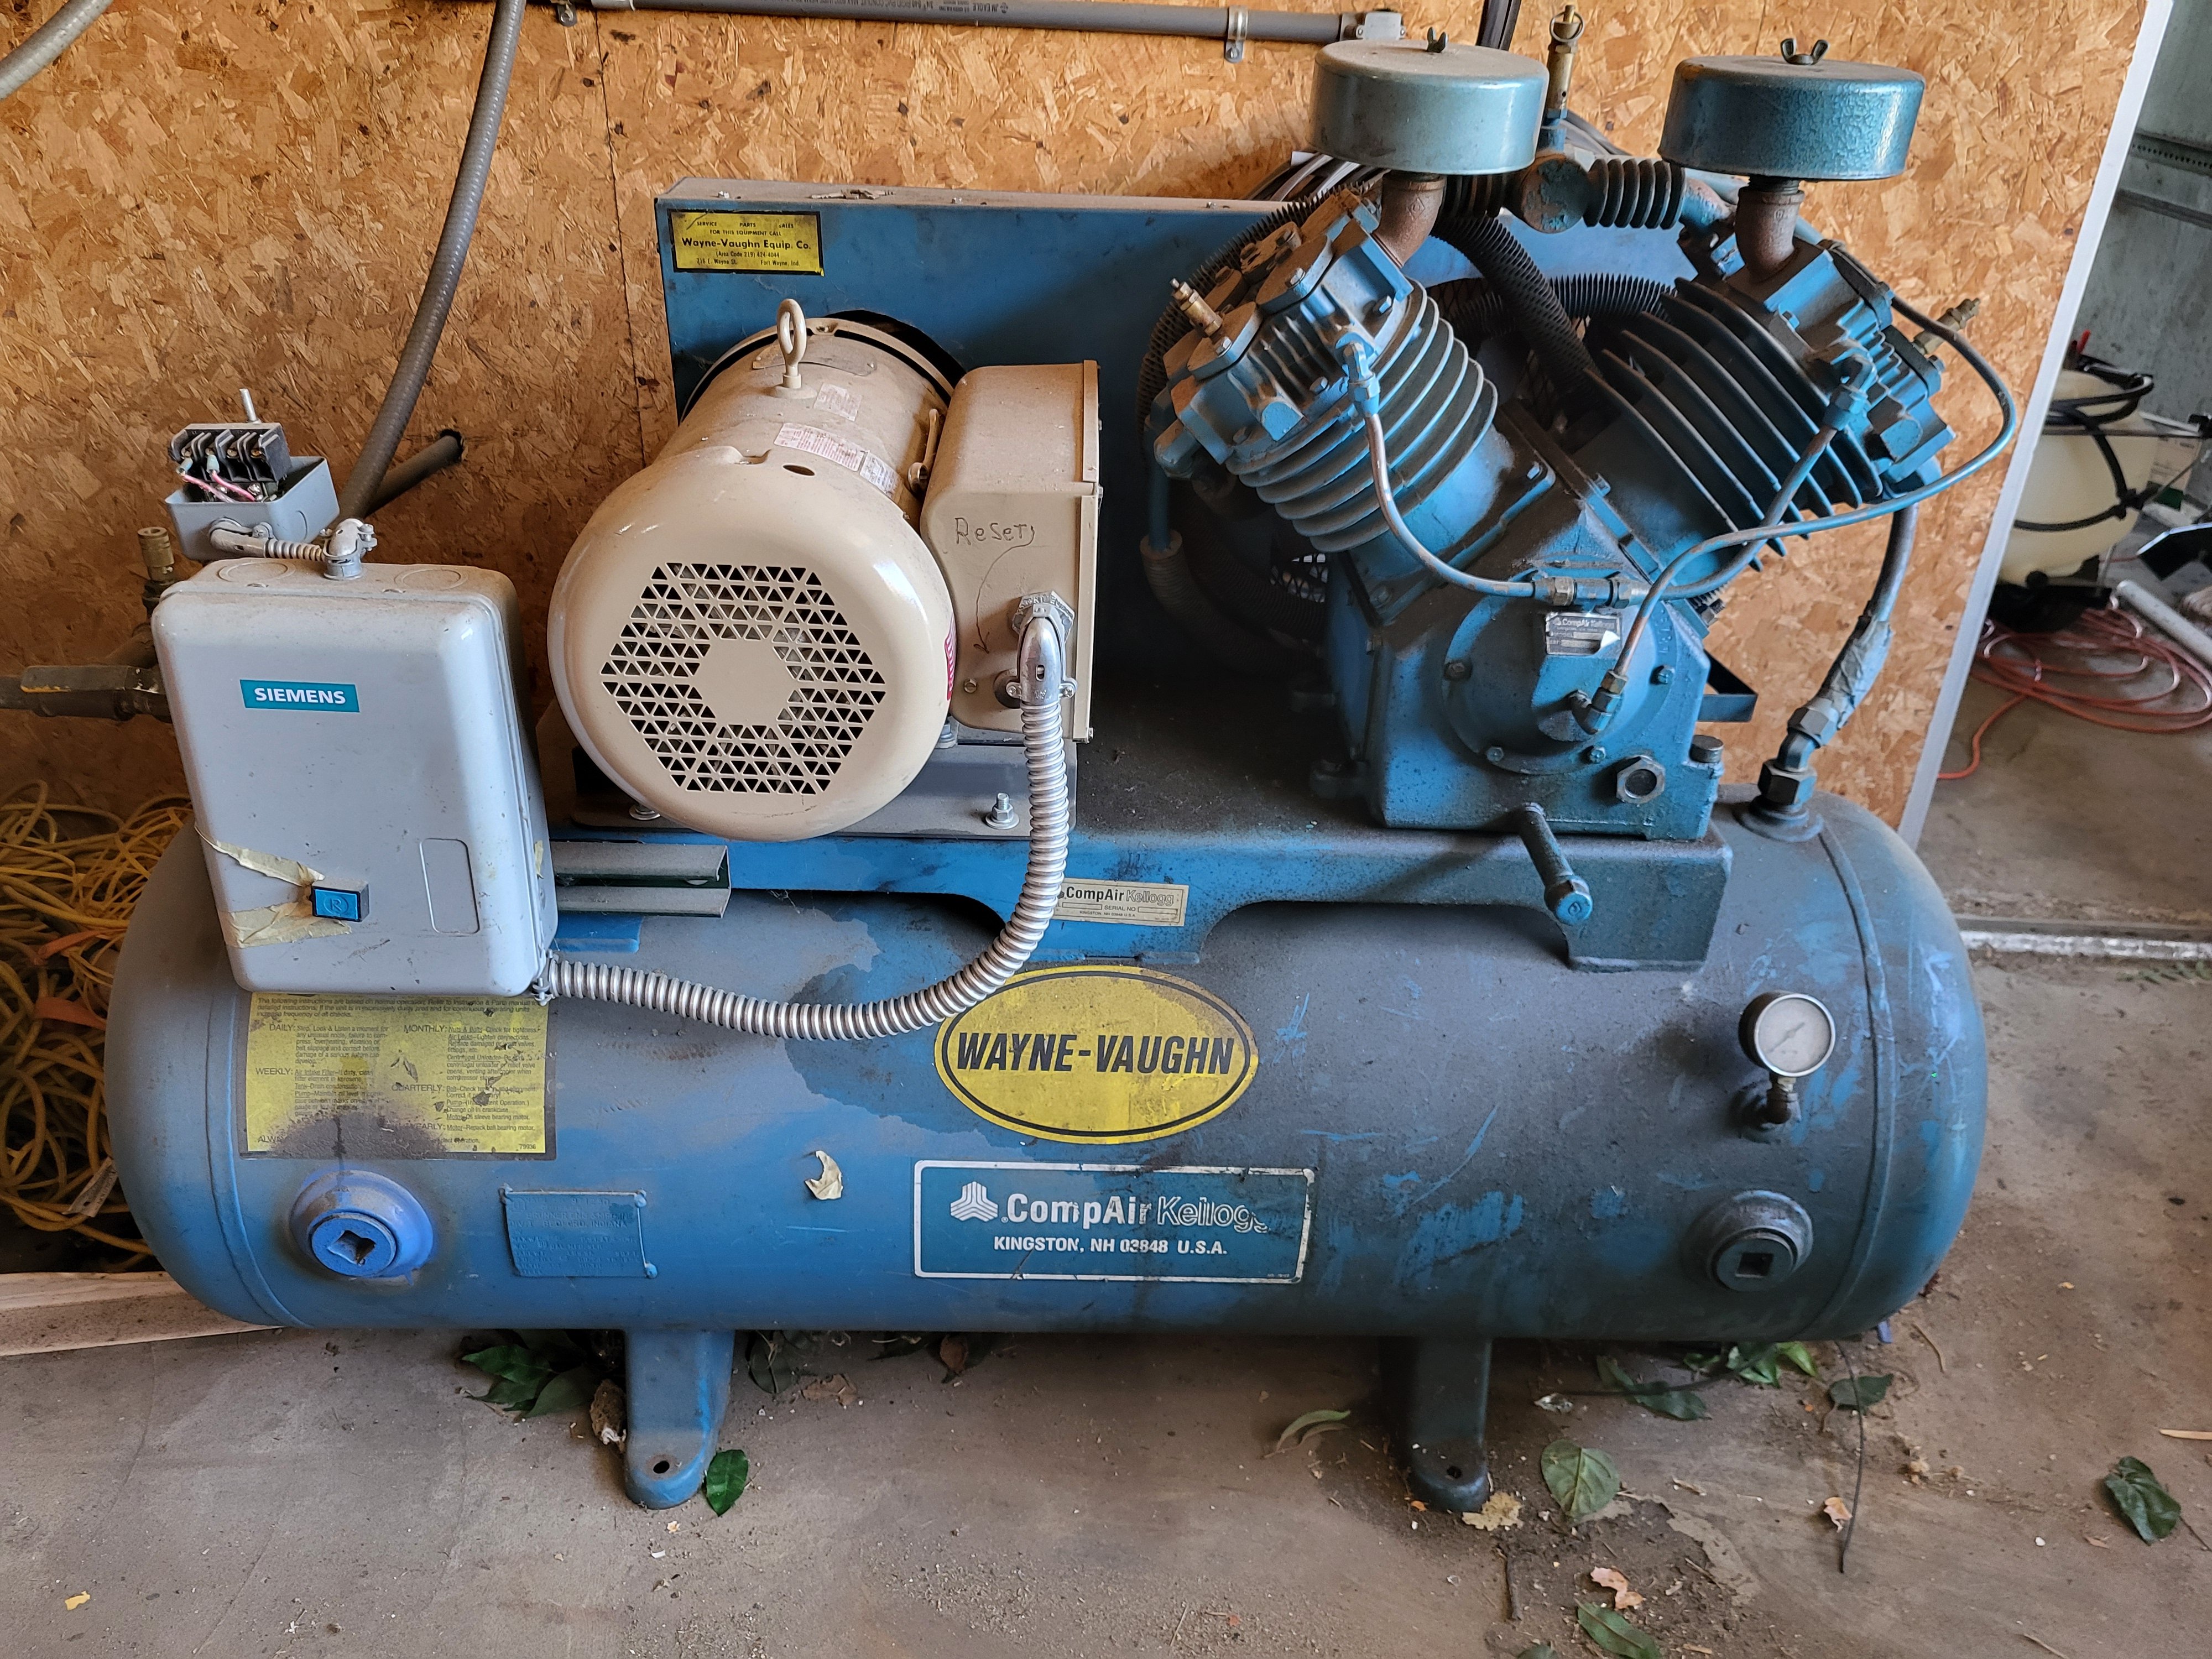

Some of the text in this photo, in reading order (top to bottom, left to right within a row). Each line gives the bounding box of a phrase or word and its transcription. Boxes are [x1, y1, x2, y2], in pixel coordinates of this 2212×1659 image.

[682, 238, 760, 248] Wayne-Vaughn
[764, 240, 793, 250] Equip.
[1562, 619, 1590, 627] CompAir
[255, 687, 346, 704] SIEMENS
[1066, 886, 1174, 906] CompAir Kellogg
[404, 1025, 447, 1033] MONTHLY:
[957, 1032, 1235, 1074] WAYNE-VAUGHN
[1007, 1193, 1151, 1230] CompAir
[994, 1235, 1228, 1255] KINGSTON, NH 03848 U.S.A.
